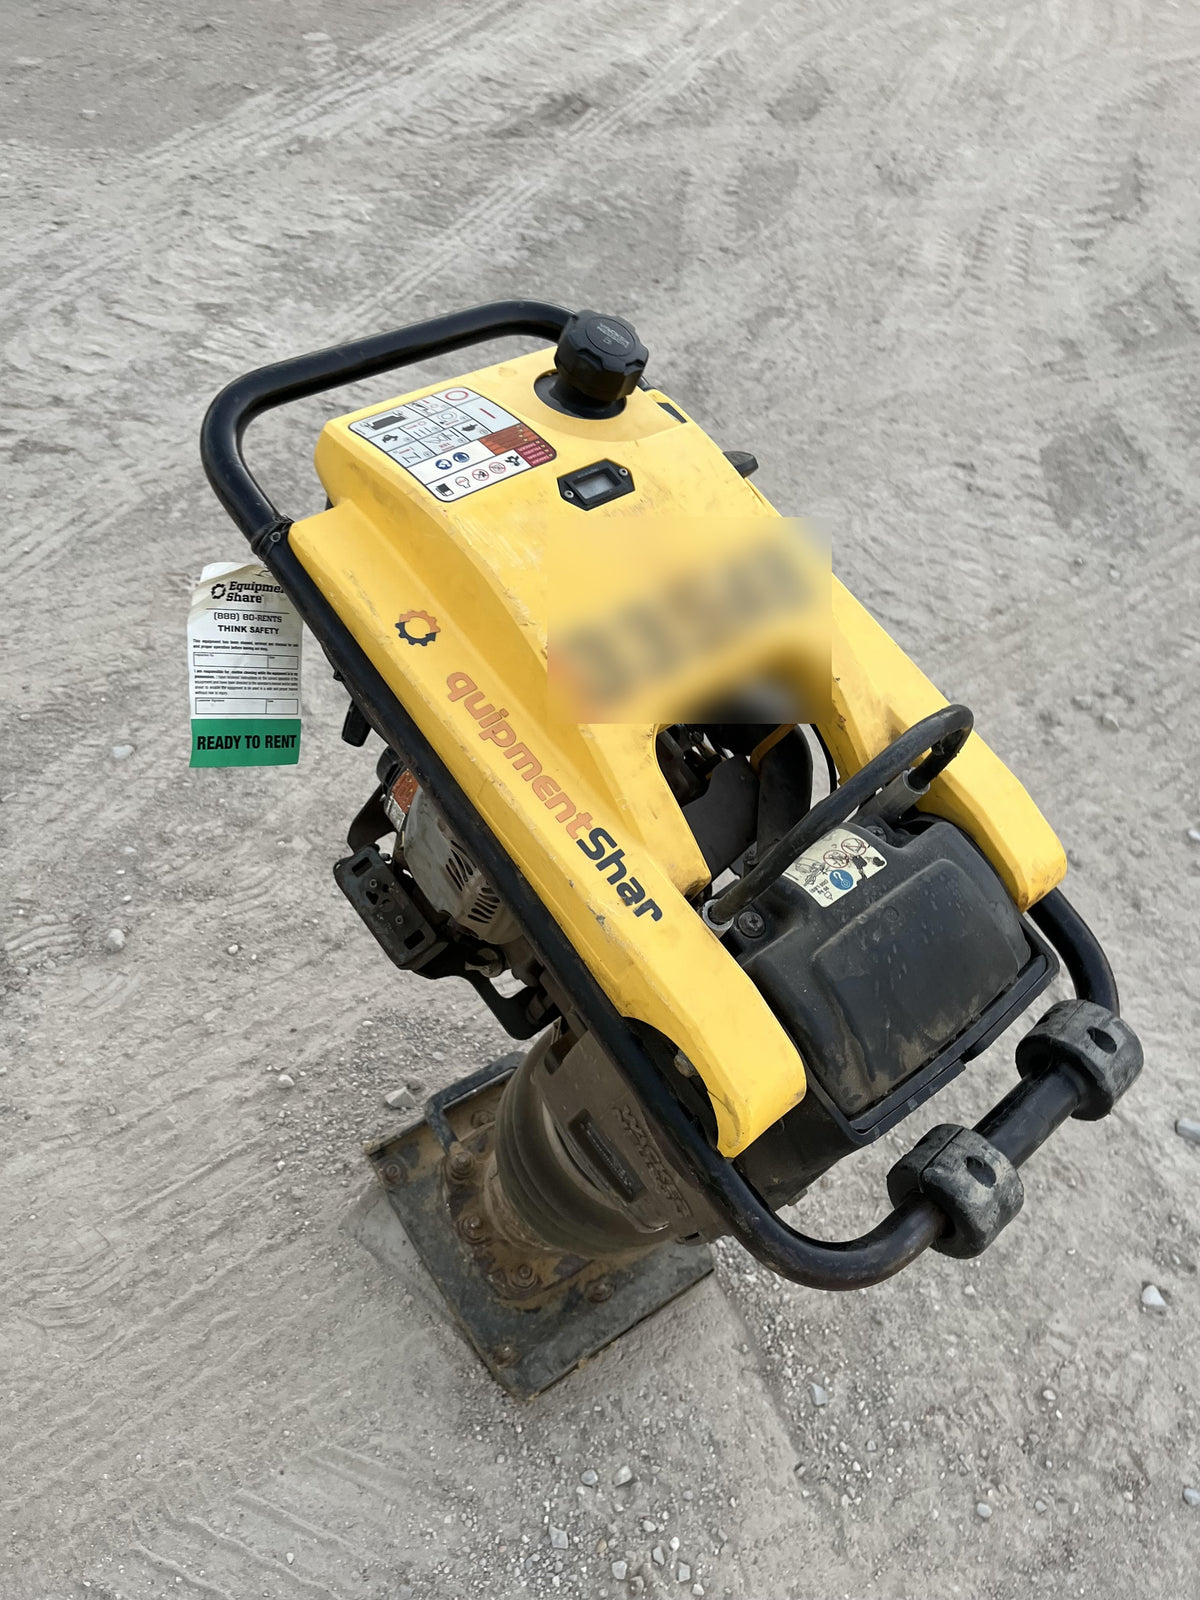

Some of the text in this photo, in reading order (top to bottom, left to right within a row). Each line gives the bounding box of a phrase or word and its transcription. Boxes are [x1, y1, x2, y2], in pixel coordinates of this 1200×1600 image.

[226, 592, 262, 603] Share
[213, 612, 282, 623] (888) 80-RENTS
[218, 625, 279, 635] THINK SAFETY
[197, 735, 297, 750] READY TO RENT
